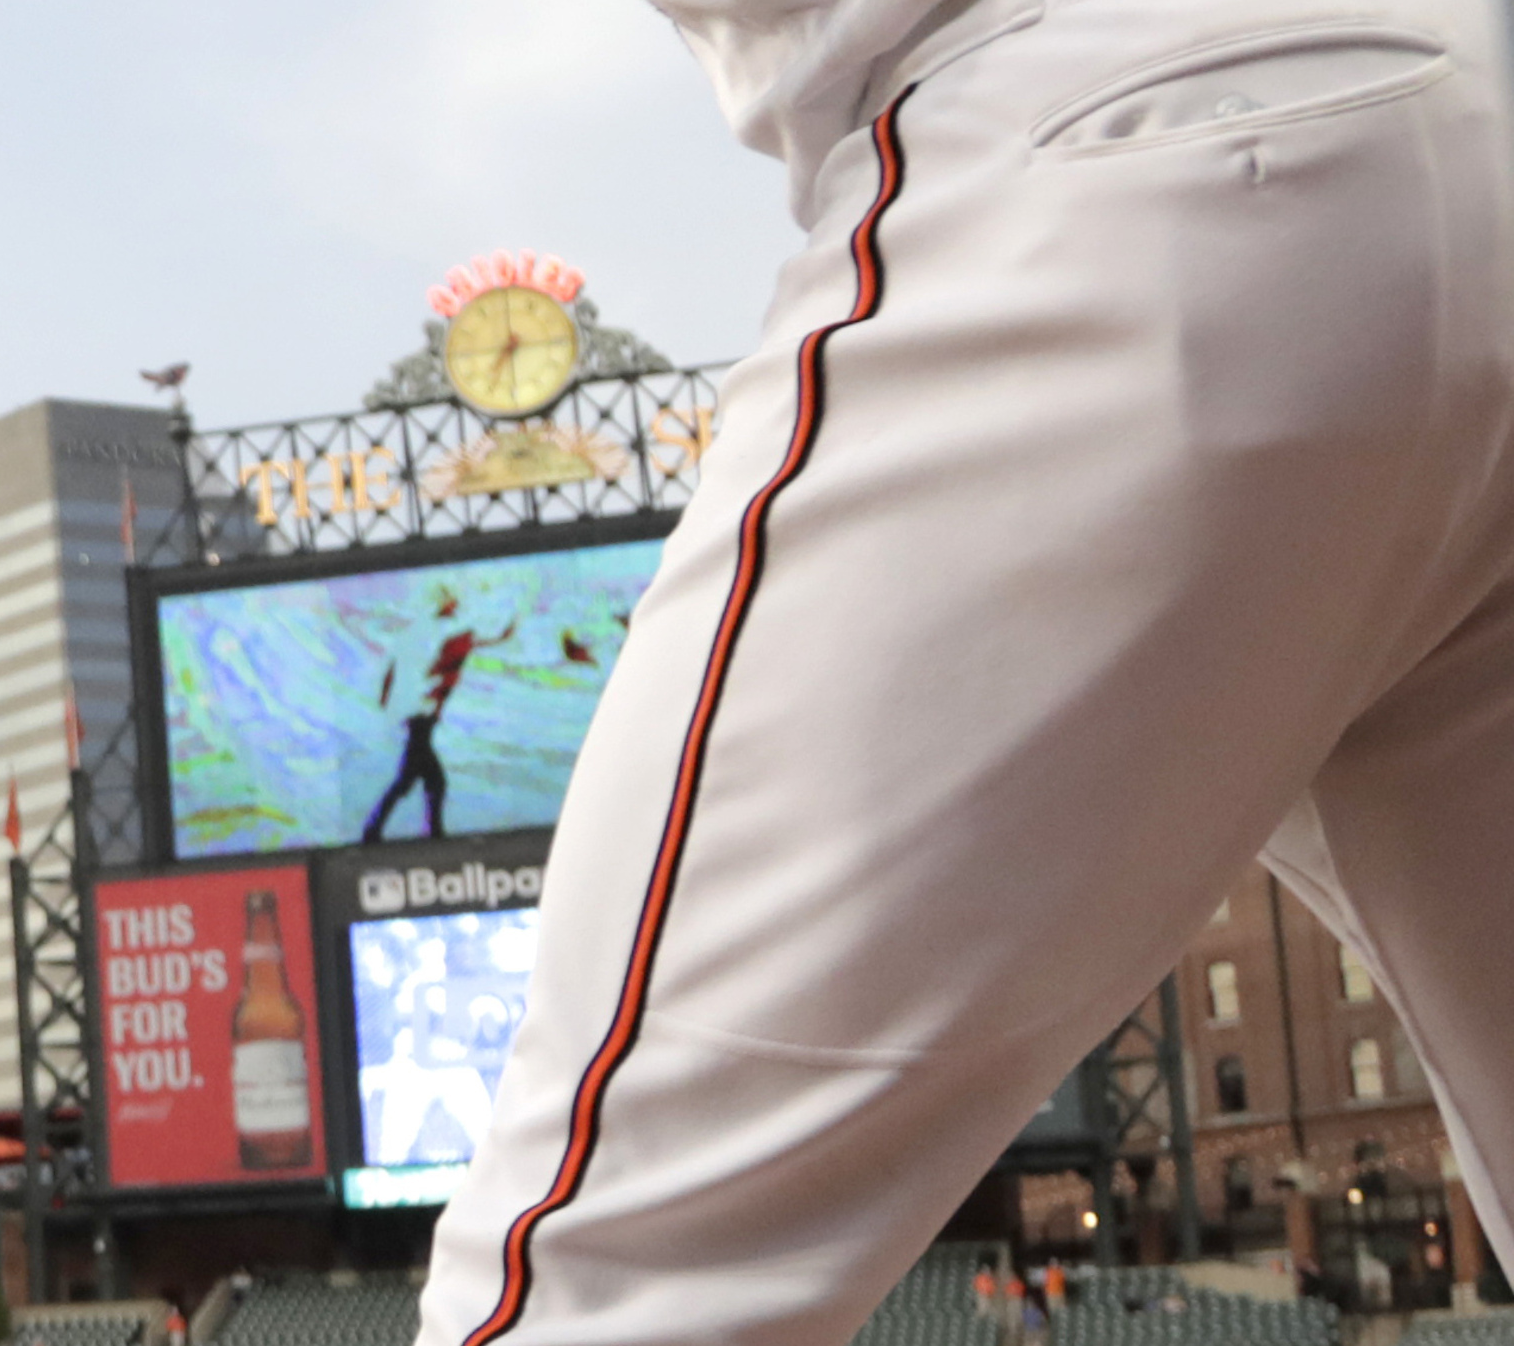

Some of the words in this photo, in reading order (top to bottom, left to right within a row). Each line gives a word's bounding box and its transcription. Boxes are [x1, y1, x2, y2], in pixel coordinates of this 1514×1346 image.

[240, 446, 402, 525] THE
[407, 862, 545, 909] Ballpa
[103, 903, 195, 949] THIS
[109, 949, 229, 998] BUD'S
[112, 1000, 188, 1046] FOR
[113, 1048, 205, 1093] YOU.
